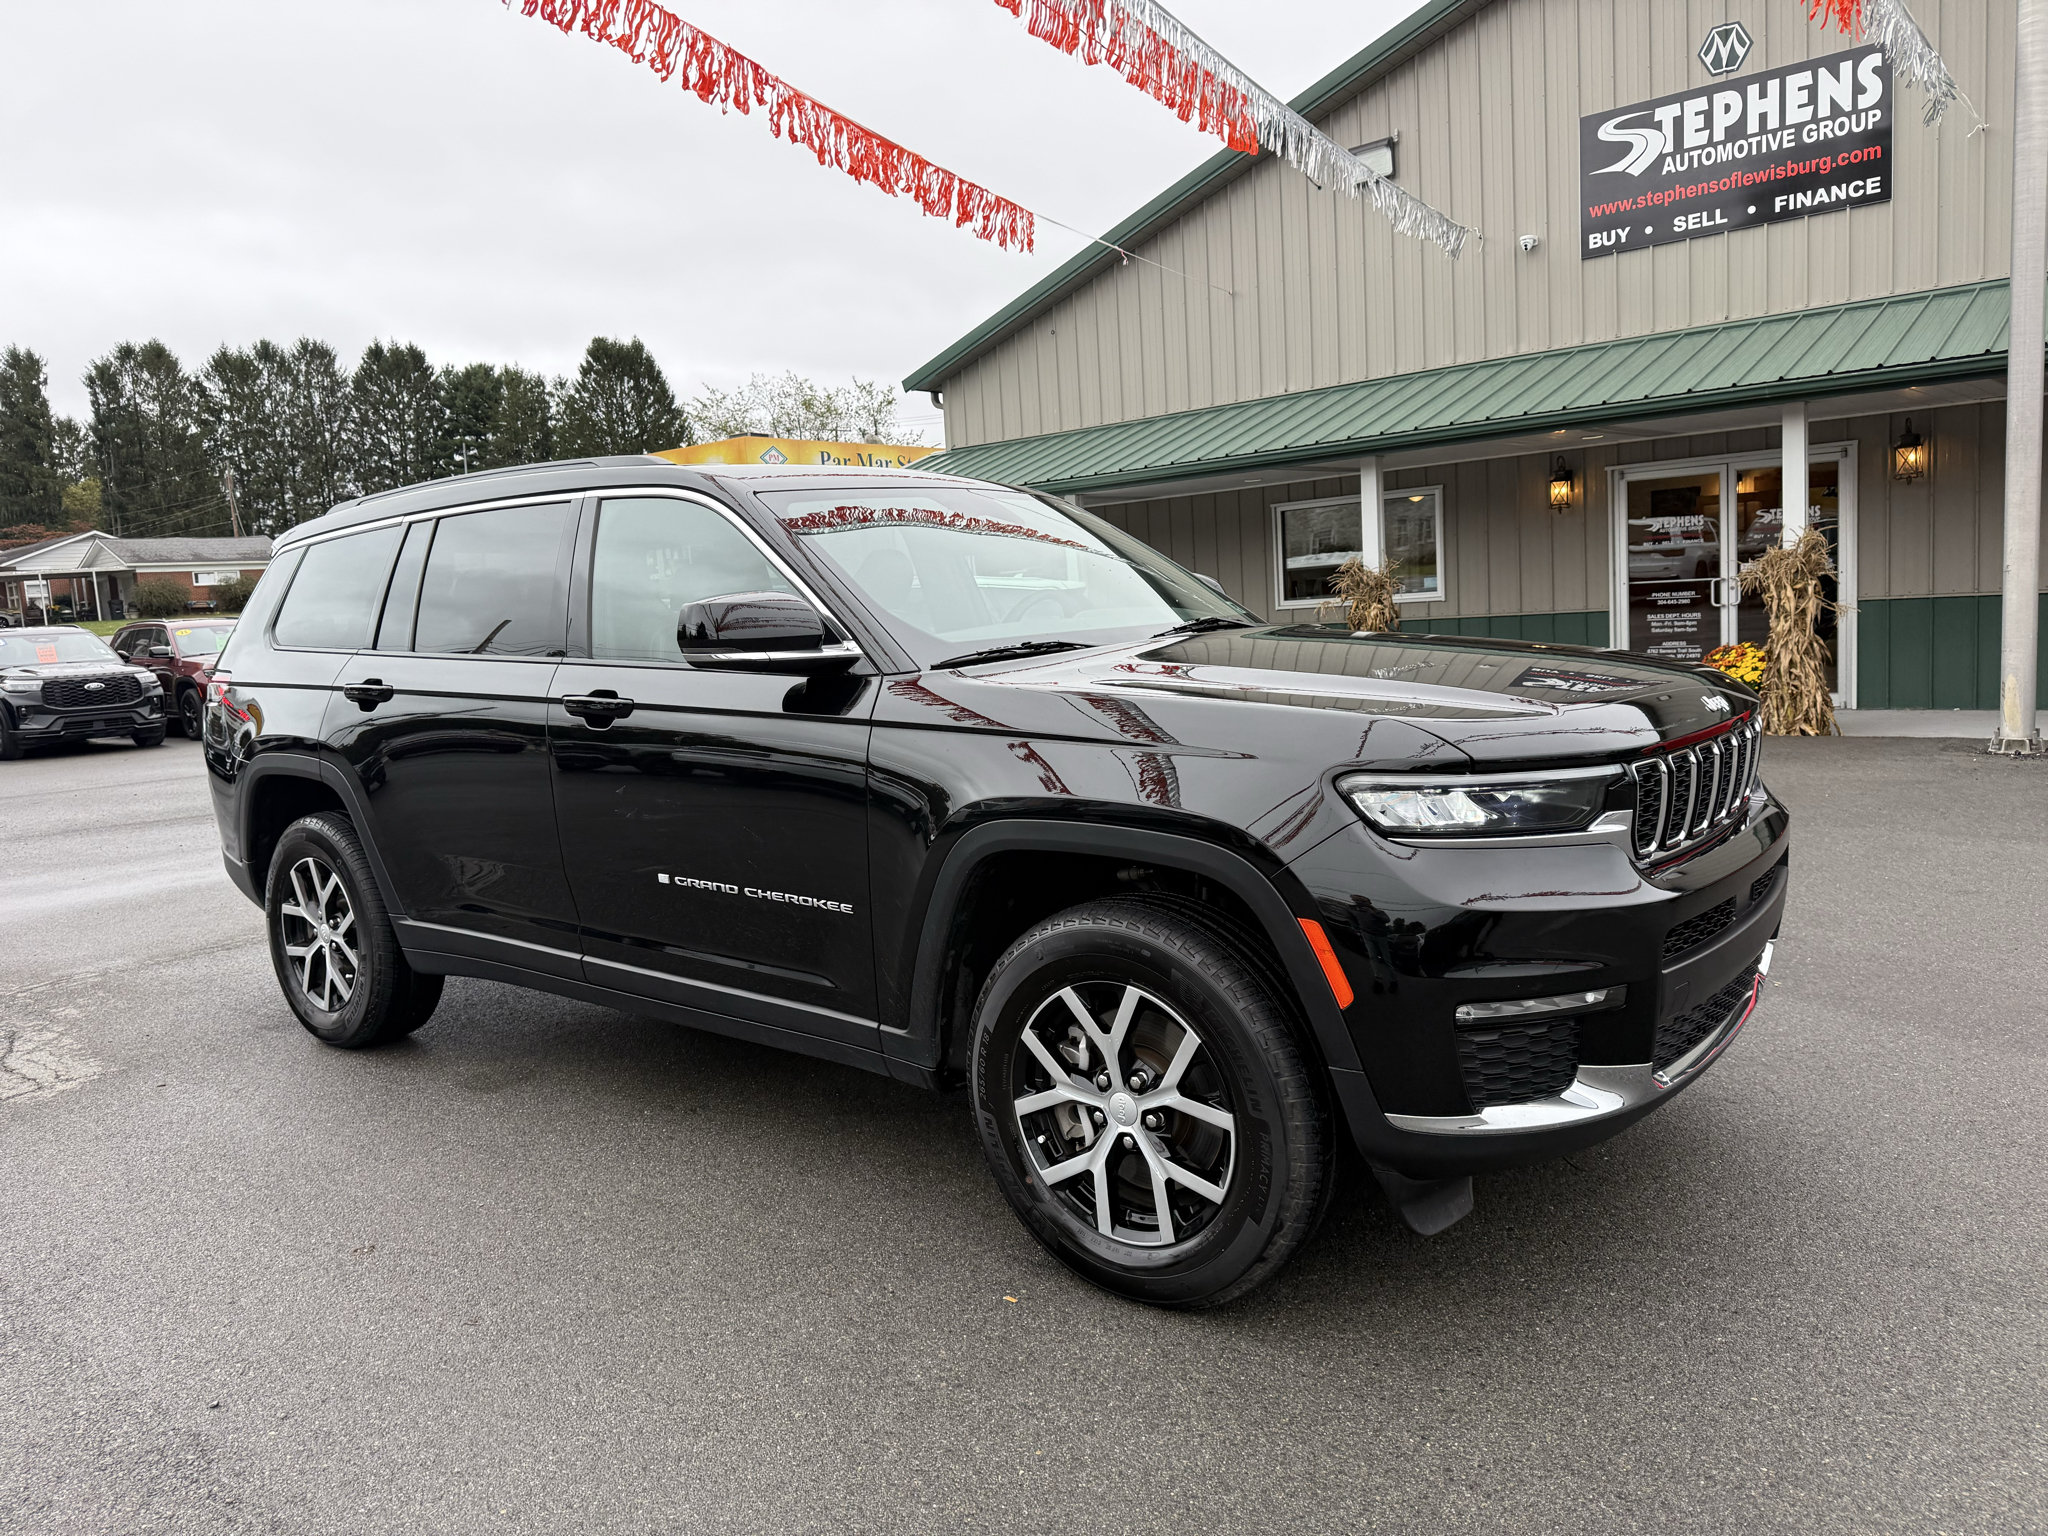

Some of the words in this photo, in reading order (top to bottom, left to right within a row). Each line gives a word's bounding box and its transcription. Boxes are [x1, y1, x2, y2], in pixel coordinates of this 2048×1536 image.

[1589, 53, 1883, 177] STEPHENS
[1662, 130, 1795, 175] AUTOMOTIVE
[1802, 110, 1882, 143] GROUP
[1589, 146, 1882, 218] www.stephensoflewisburg.com
[1588, 227, 1631, 249] BUY
[1673, 209, 1728, 232] SELL
[1774, 176, 1882, 212] FINANCE
[819, 451, 851, 466] Par
[856, 453, 893, 468] Mar
[1643, 514, 1704, 532] STEPHENS
[674, 876, 738, 894] GRAND
[744, 888, 854, 914] CHEROKEE
[1117, 1096, 1126, 1122] Jeep
